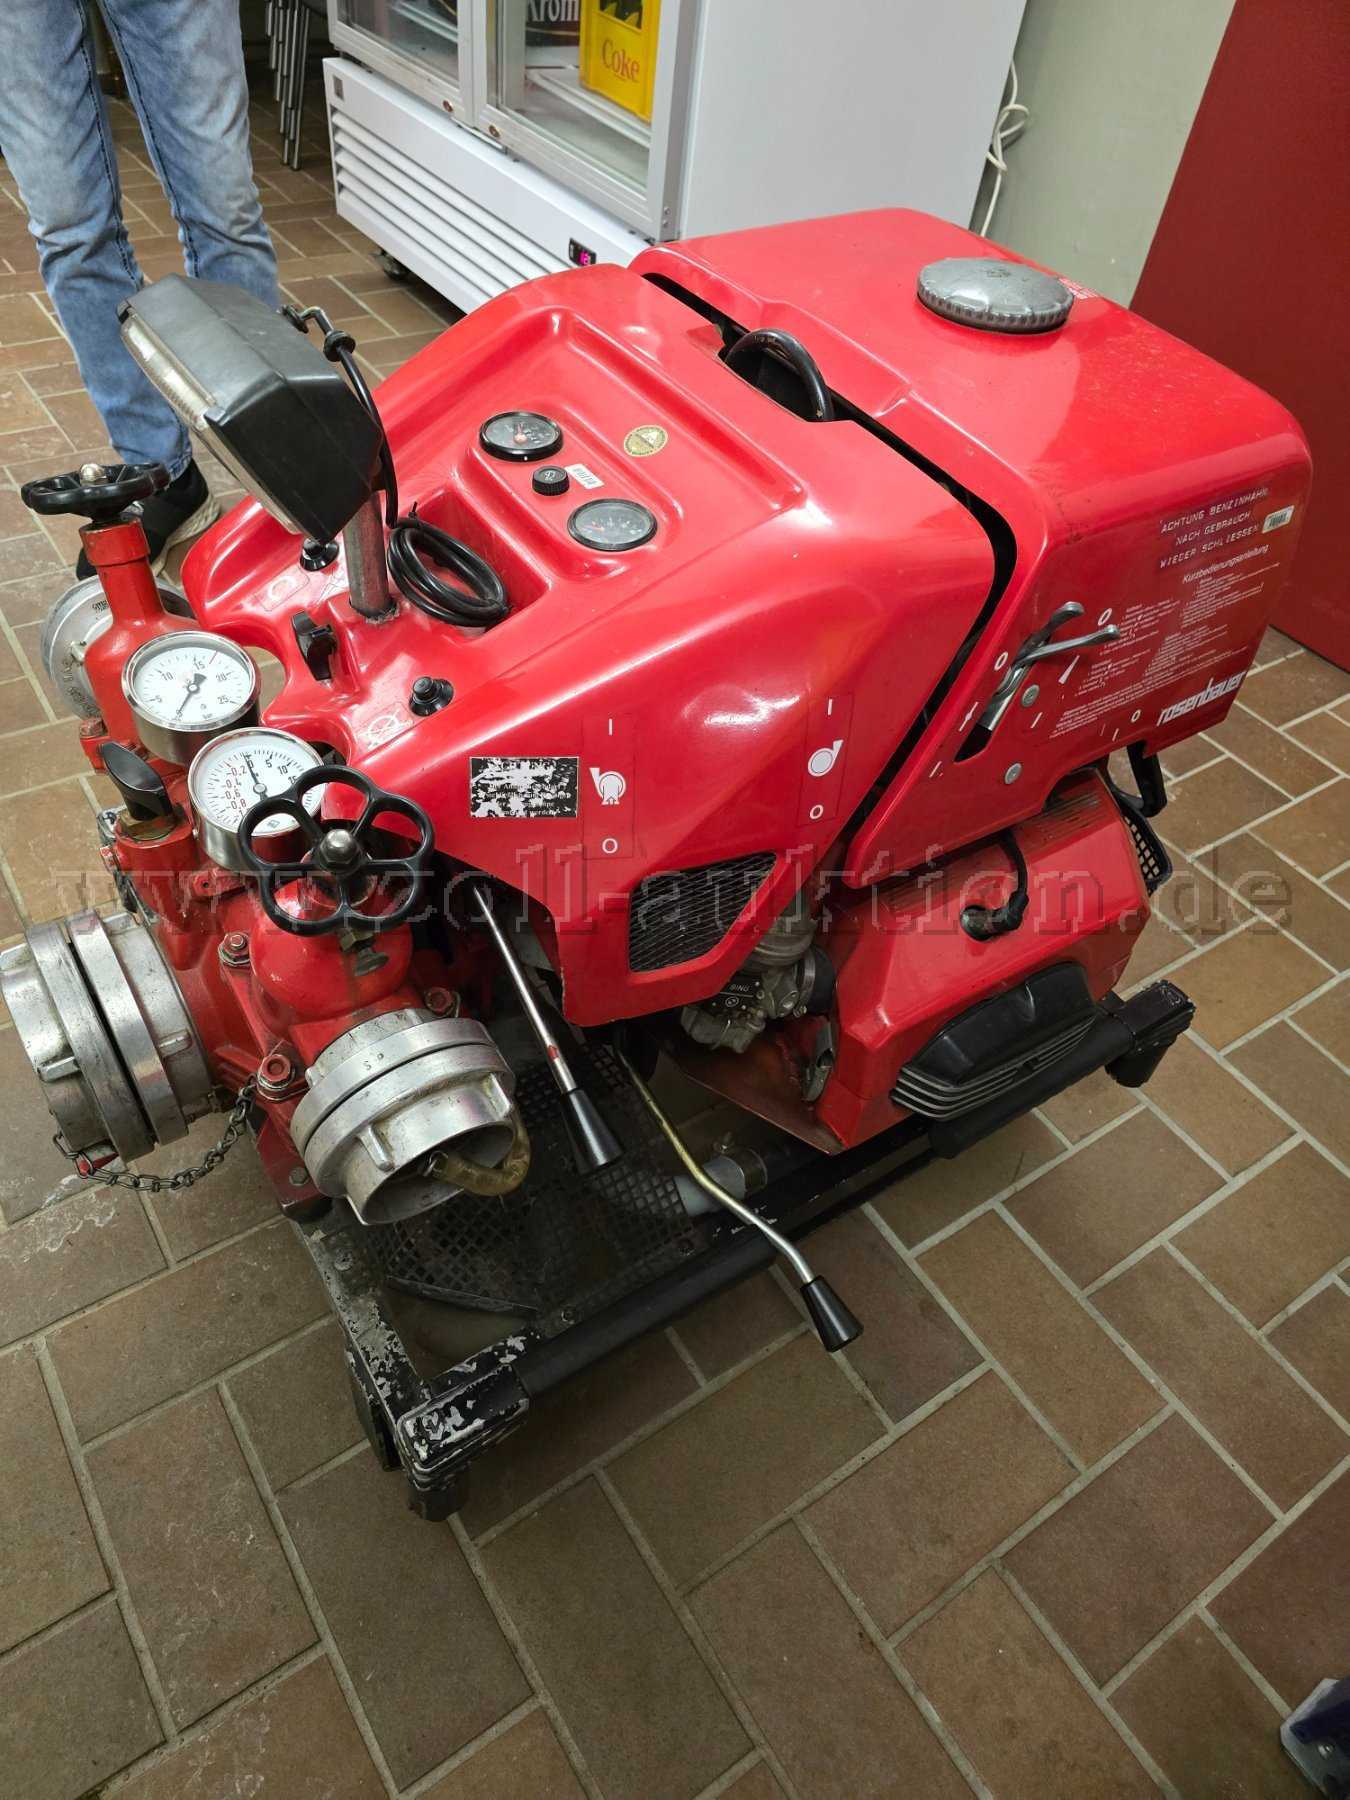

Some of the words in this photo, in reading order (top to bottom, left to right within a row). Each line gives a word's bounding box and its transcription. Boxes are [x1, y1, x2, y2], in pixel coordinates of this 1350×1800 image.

[602, 39, 641, 82] Coke
[1161, 510, 1205, 533] ACHTUNG
[1176, 530, 1200, 546] NACH
[1204, 511, 1251, 535] GEBRAUCH
[1160, 548, 1197, 569] WIEDER
[193, 661, 206, 670] 15
[161, 671, 174, 681] 10
[215, 673, 227, 682] 20
[217, 695, 230, 704] 25
[265, 760, 273, 768] 5
[277, 765, 288, 775] 10
[225, 799, 247, 810] -0.8
